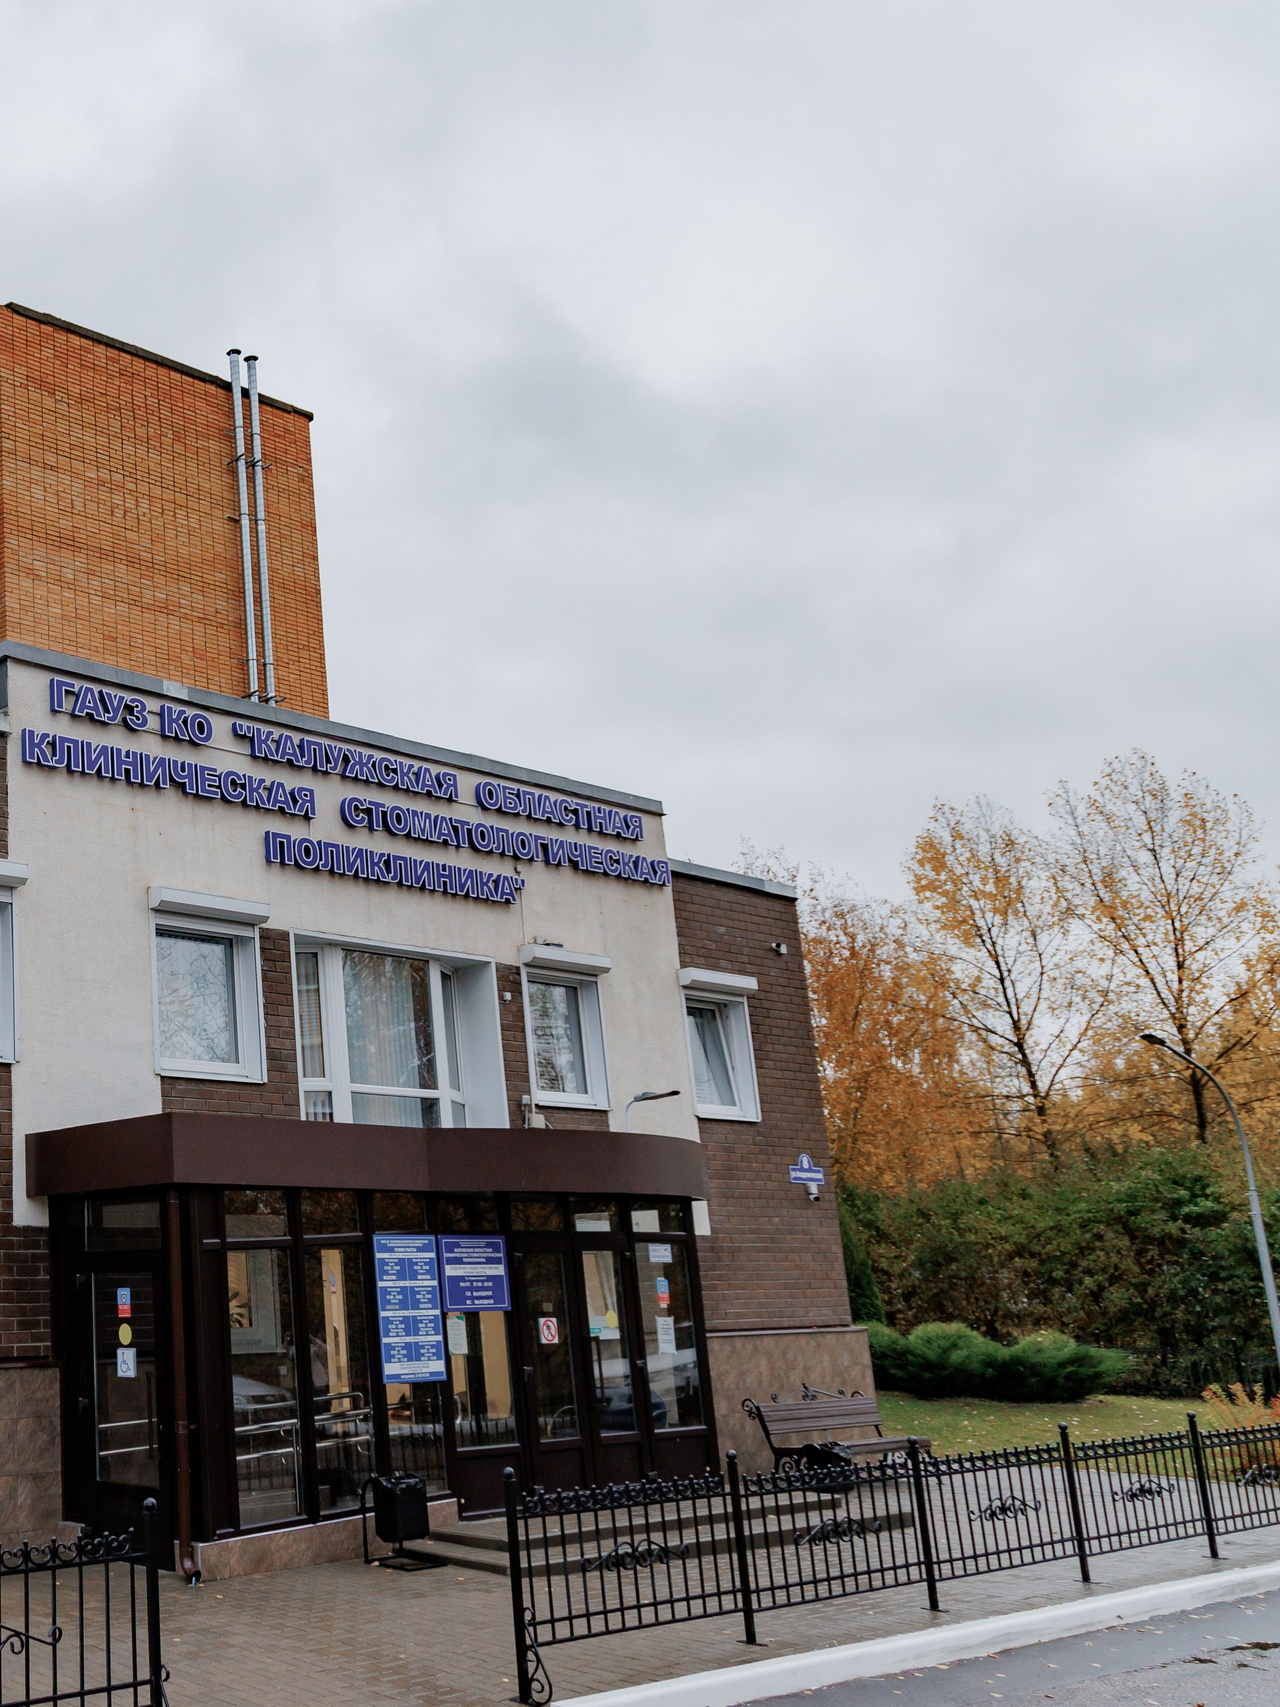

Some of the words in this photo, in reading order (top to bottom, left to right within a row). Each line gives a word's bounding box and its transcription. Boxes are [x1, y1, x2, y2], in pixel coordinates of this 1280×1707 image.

[21, 727, 317, 820] КЛИНИЧЕСКАЯ
[341, 796, 672, 887] СТОМАТОЛОГИЧЕСКАЯ
[49, 677, 150, 731] ГАУЗ
[160, 703, 214, 746] КО
[232, 721, 459, 801] "КАЛУЖСКАЯ
[475, 780, 644, 841] ОБЛАСТНАЯ
[264, 830, 526, 905] ПОЛИКЛИНИКА"
